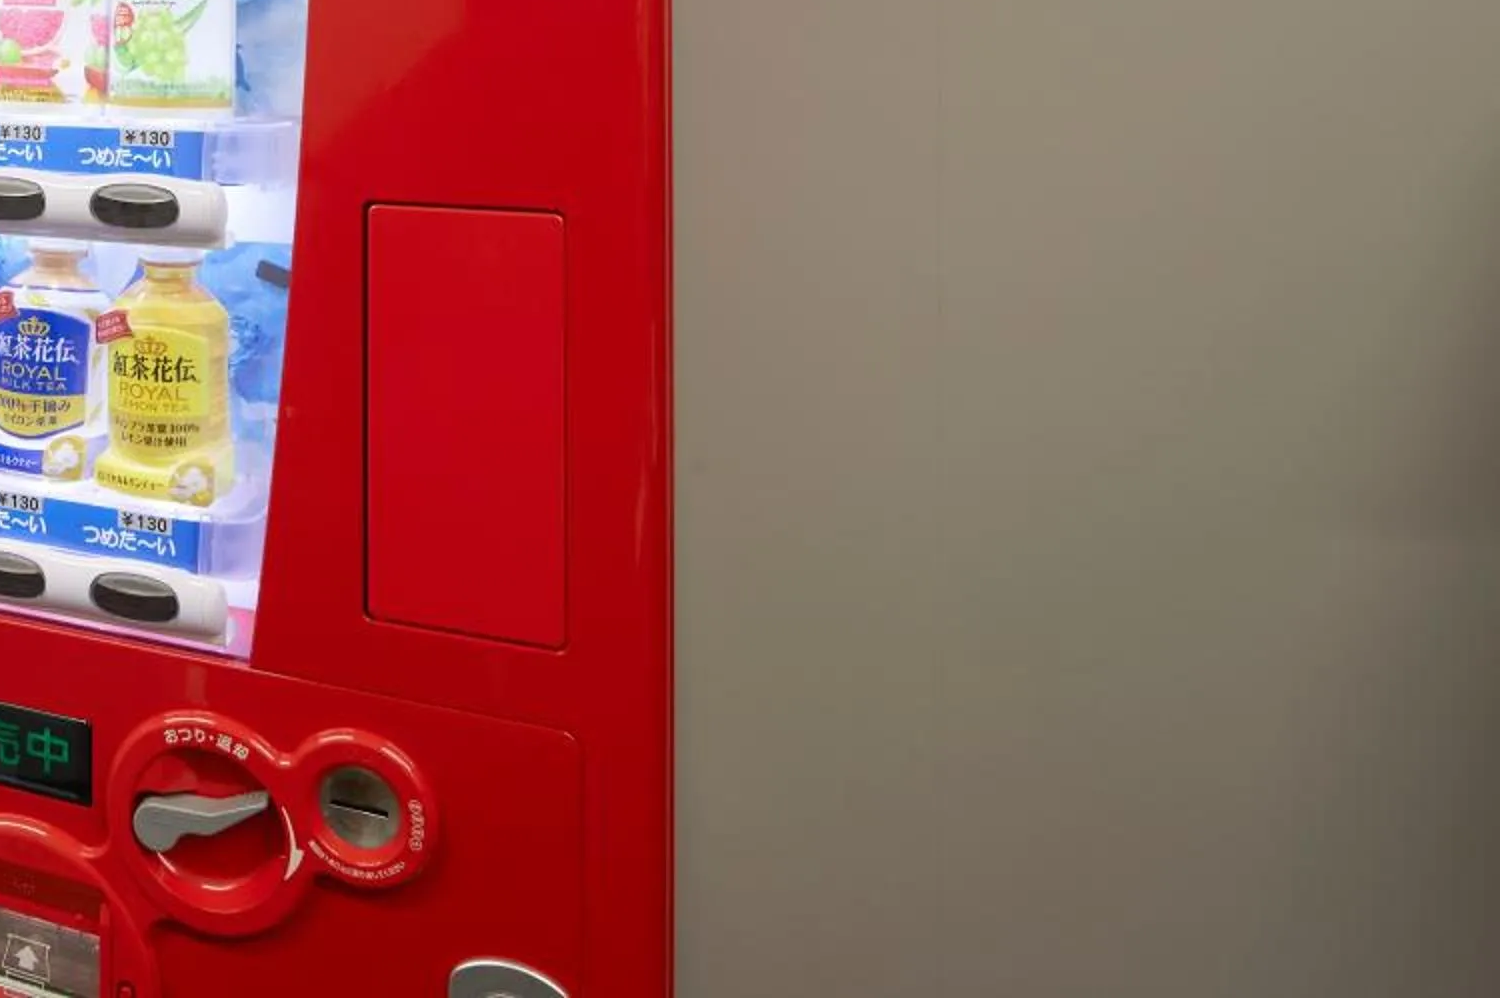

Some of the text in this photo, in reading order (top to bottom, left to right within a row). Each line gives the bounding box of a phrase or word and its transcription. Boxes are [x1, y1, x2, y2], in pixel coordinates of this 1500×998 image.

[0, 124, 42, 140] ¥130
[124, 130, 171, 146] ¥130
[1, 361, 68, 381] ROYAL
[113, 351, 201, 384] 紅茶花伝
[37, 381, 68, 392] TEA
[118, 381, 190, 402] ROYAL
[121, 512, 168, 532] ¥130
